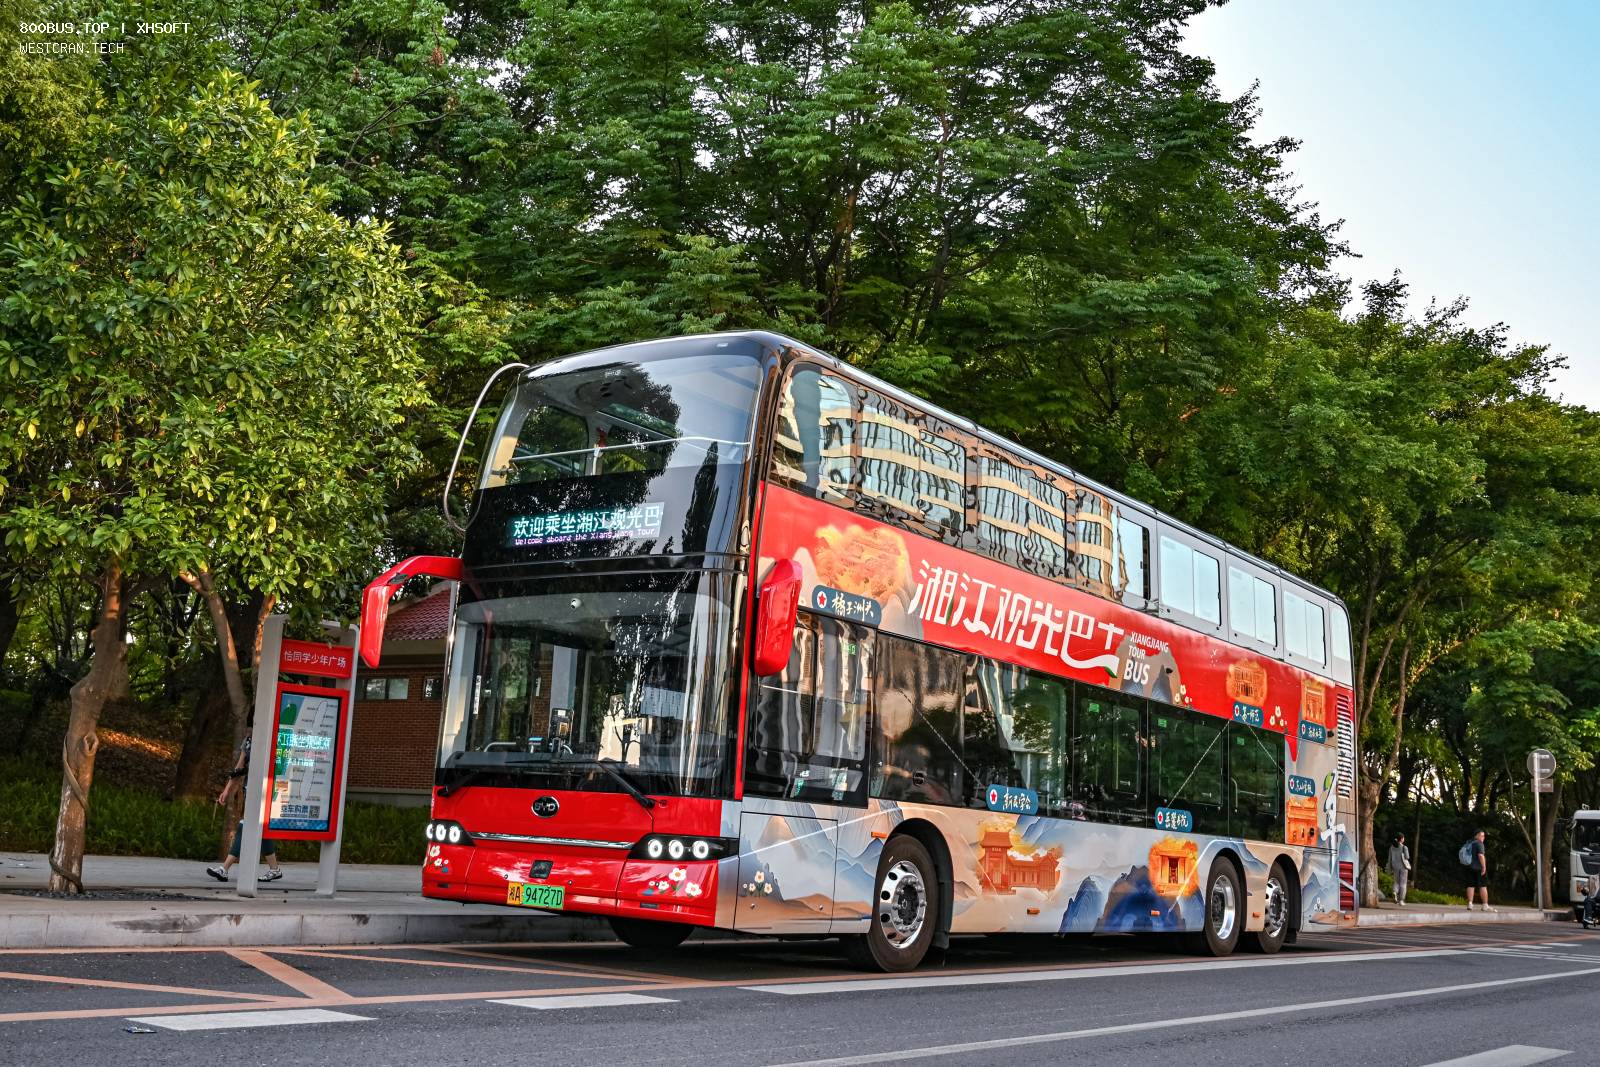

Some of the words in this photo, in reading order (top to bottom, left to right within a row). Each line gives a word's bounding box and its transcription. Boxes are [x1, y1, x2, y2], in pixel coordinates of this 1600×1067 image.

[575, 533, 587, 541] the
[831, 592, 874, 621] 橘子洲头
[907, 559, 1125, 678] 湘江观光巴士
[1128, 645, 1146, 660] TOUR
[1130, 631, 1169, 653] XIANGJIANG
[284, 650, 347, 668] 恰同学少年广场
[1123, 659, 1150, 685] BUS
